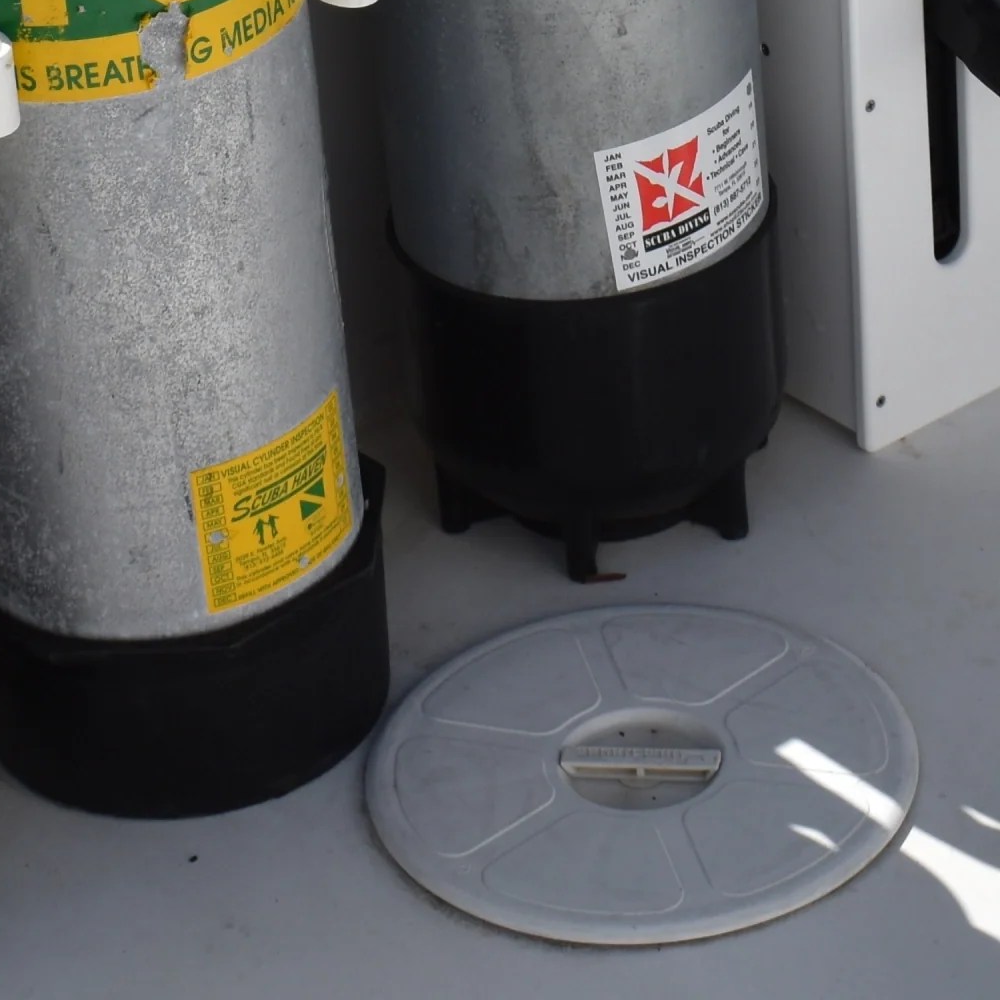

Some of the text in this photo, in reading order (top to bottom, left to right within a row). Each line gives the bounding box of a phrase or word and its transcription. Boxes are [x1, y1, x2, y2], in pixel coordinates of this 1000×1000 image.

[604, 152, 622, 163] JAN
[605, 162, 623, 172] FEB
[606, 171, 626, 182] MAR
[609, 182, 627, 192] APR
[610, 192, 629, 202] MAY
[612, 202, 630, 212] JUN
[615, 212, 631, 222] JUL
[615, 221, 634, 232] AUG
[645, 230, 676, 248] SCUBA
[678, 211, 709, 235] DIVING
[617, 231, 635, 241] SEP
[627, 261, 673, 283] VISUAL
[675, 223, 735, 267] INSPECTION
[736, 192, 763, 229] STICKER
[619, 241, 637, 251] OCT
[621, 250, 639, 262] NV
[622, 260, 641, 271] DEC
[221, 461, 250, 478] VISUAL
[253, 440, 290, 467] CYLINDER
[291, 414, 325, 444] INSPECTION
[231, 482, 289, 522] SCUBA
[291, 452, 326, 490] HAVEN
